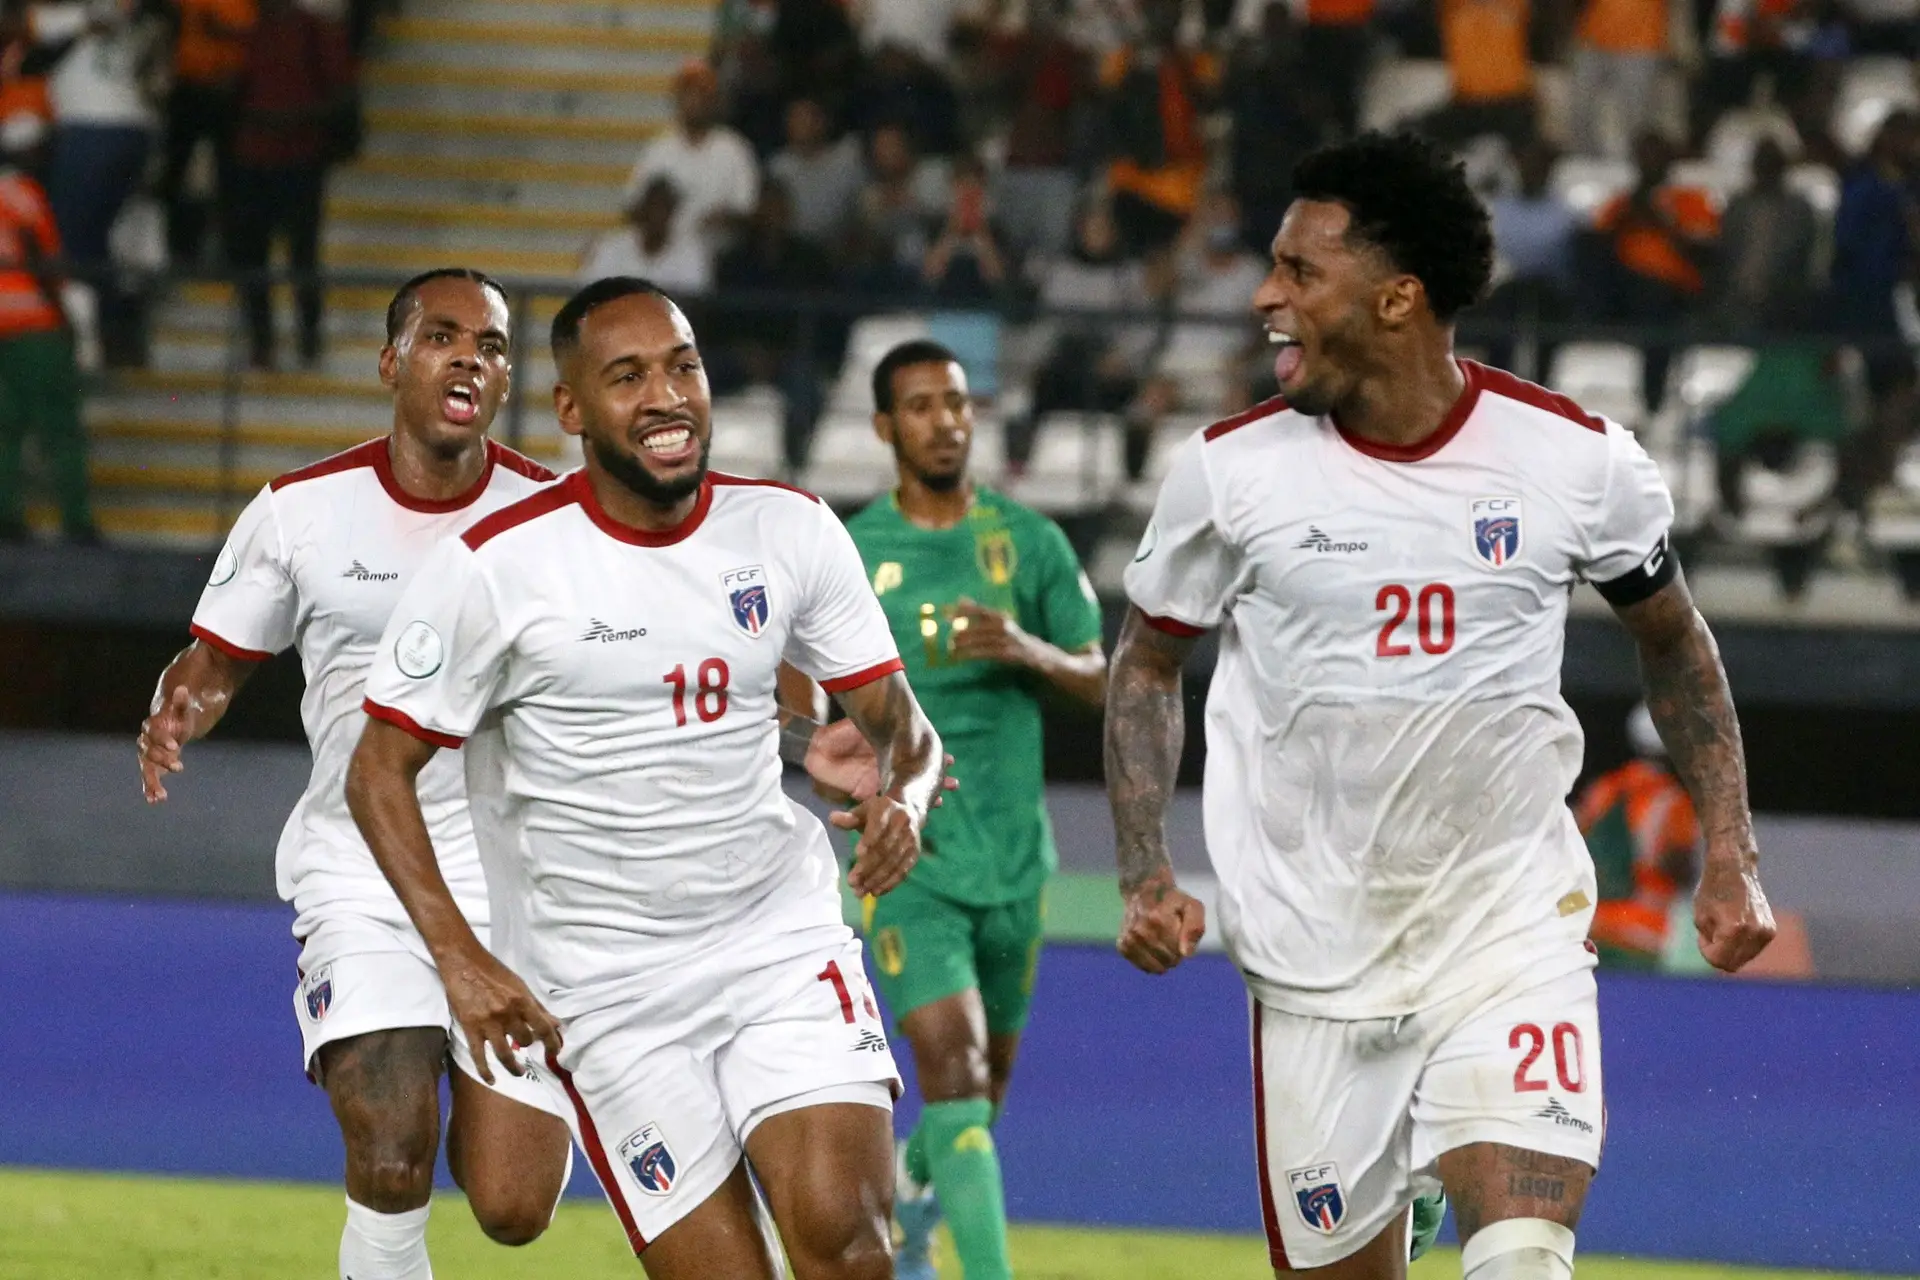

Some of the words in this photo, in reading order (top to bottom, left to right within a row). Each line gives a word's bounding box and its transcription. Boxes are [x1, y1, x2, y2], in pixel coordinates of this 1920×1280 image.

[1472, 499, 1517, 513] FCF
[1317, 539, 1369, 554] tempo
[357, 572, 399, 582] tempo
[724, 569, 760, 587] FCF
[1375, 582, 1456, 657] 20
[601, 627, 648, 643] tempo
[663, 657, 730, 728] 18
[303, 967, 329, 991] FCF
[1508, 1021, 1588, 1094] 20
[1555, 1114, 1593, 1134] tempo
[621, 1127, 653, 1158] FCF
[1290, 1166, 1331, 1184] FCF
